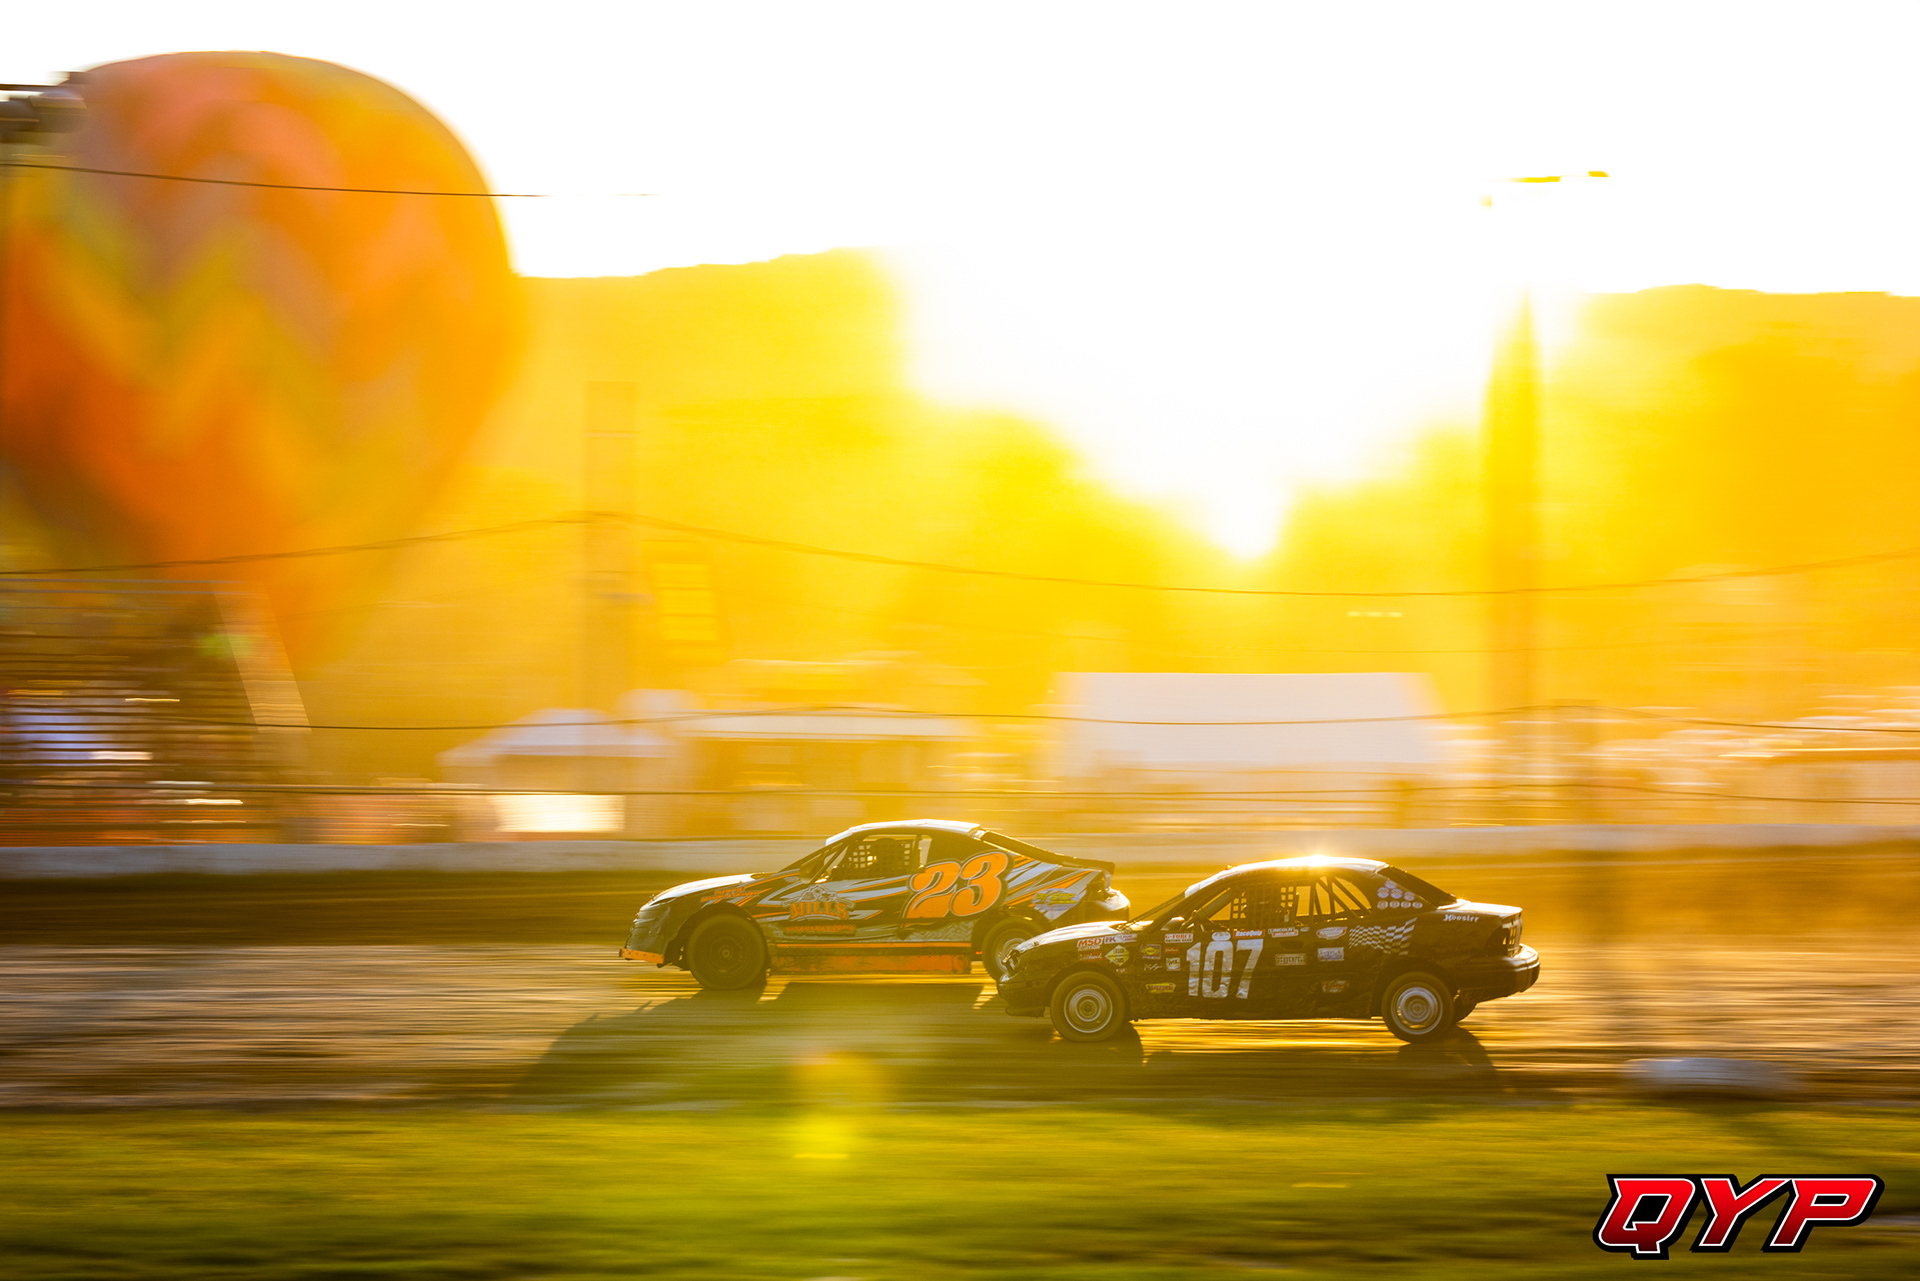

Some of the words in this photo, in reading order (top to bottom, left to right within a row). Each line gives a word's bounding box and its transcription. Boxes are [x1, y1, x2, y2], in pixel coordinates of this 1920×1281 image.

[901, 851, 1008, 921] 23
[1050, 892, 1076, 901] STOP
[789, 901, 848, 920] MILLS
[1235, 929, 1263, 937] RaceQuip
[1078, 937, 1102, 947] MSD
[1186, 938, 1264, 999] 107
